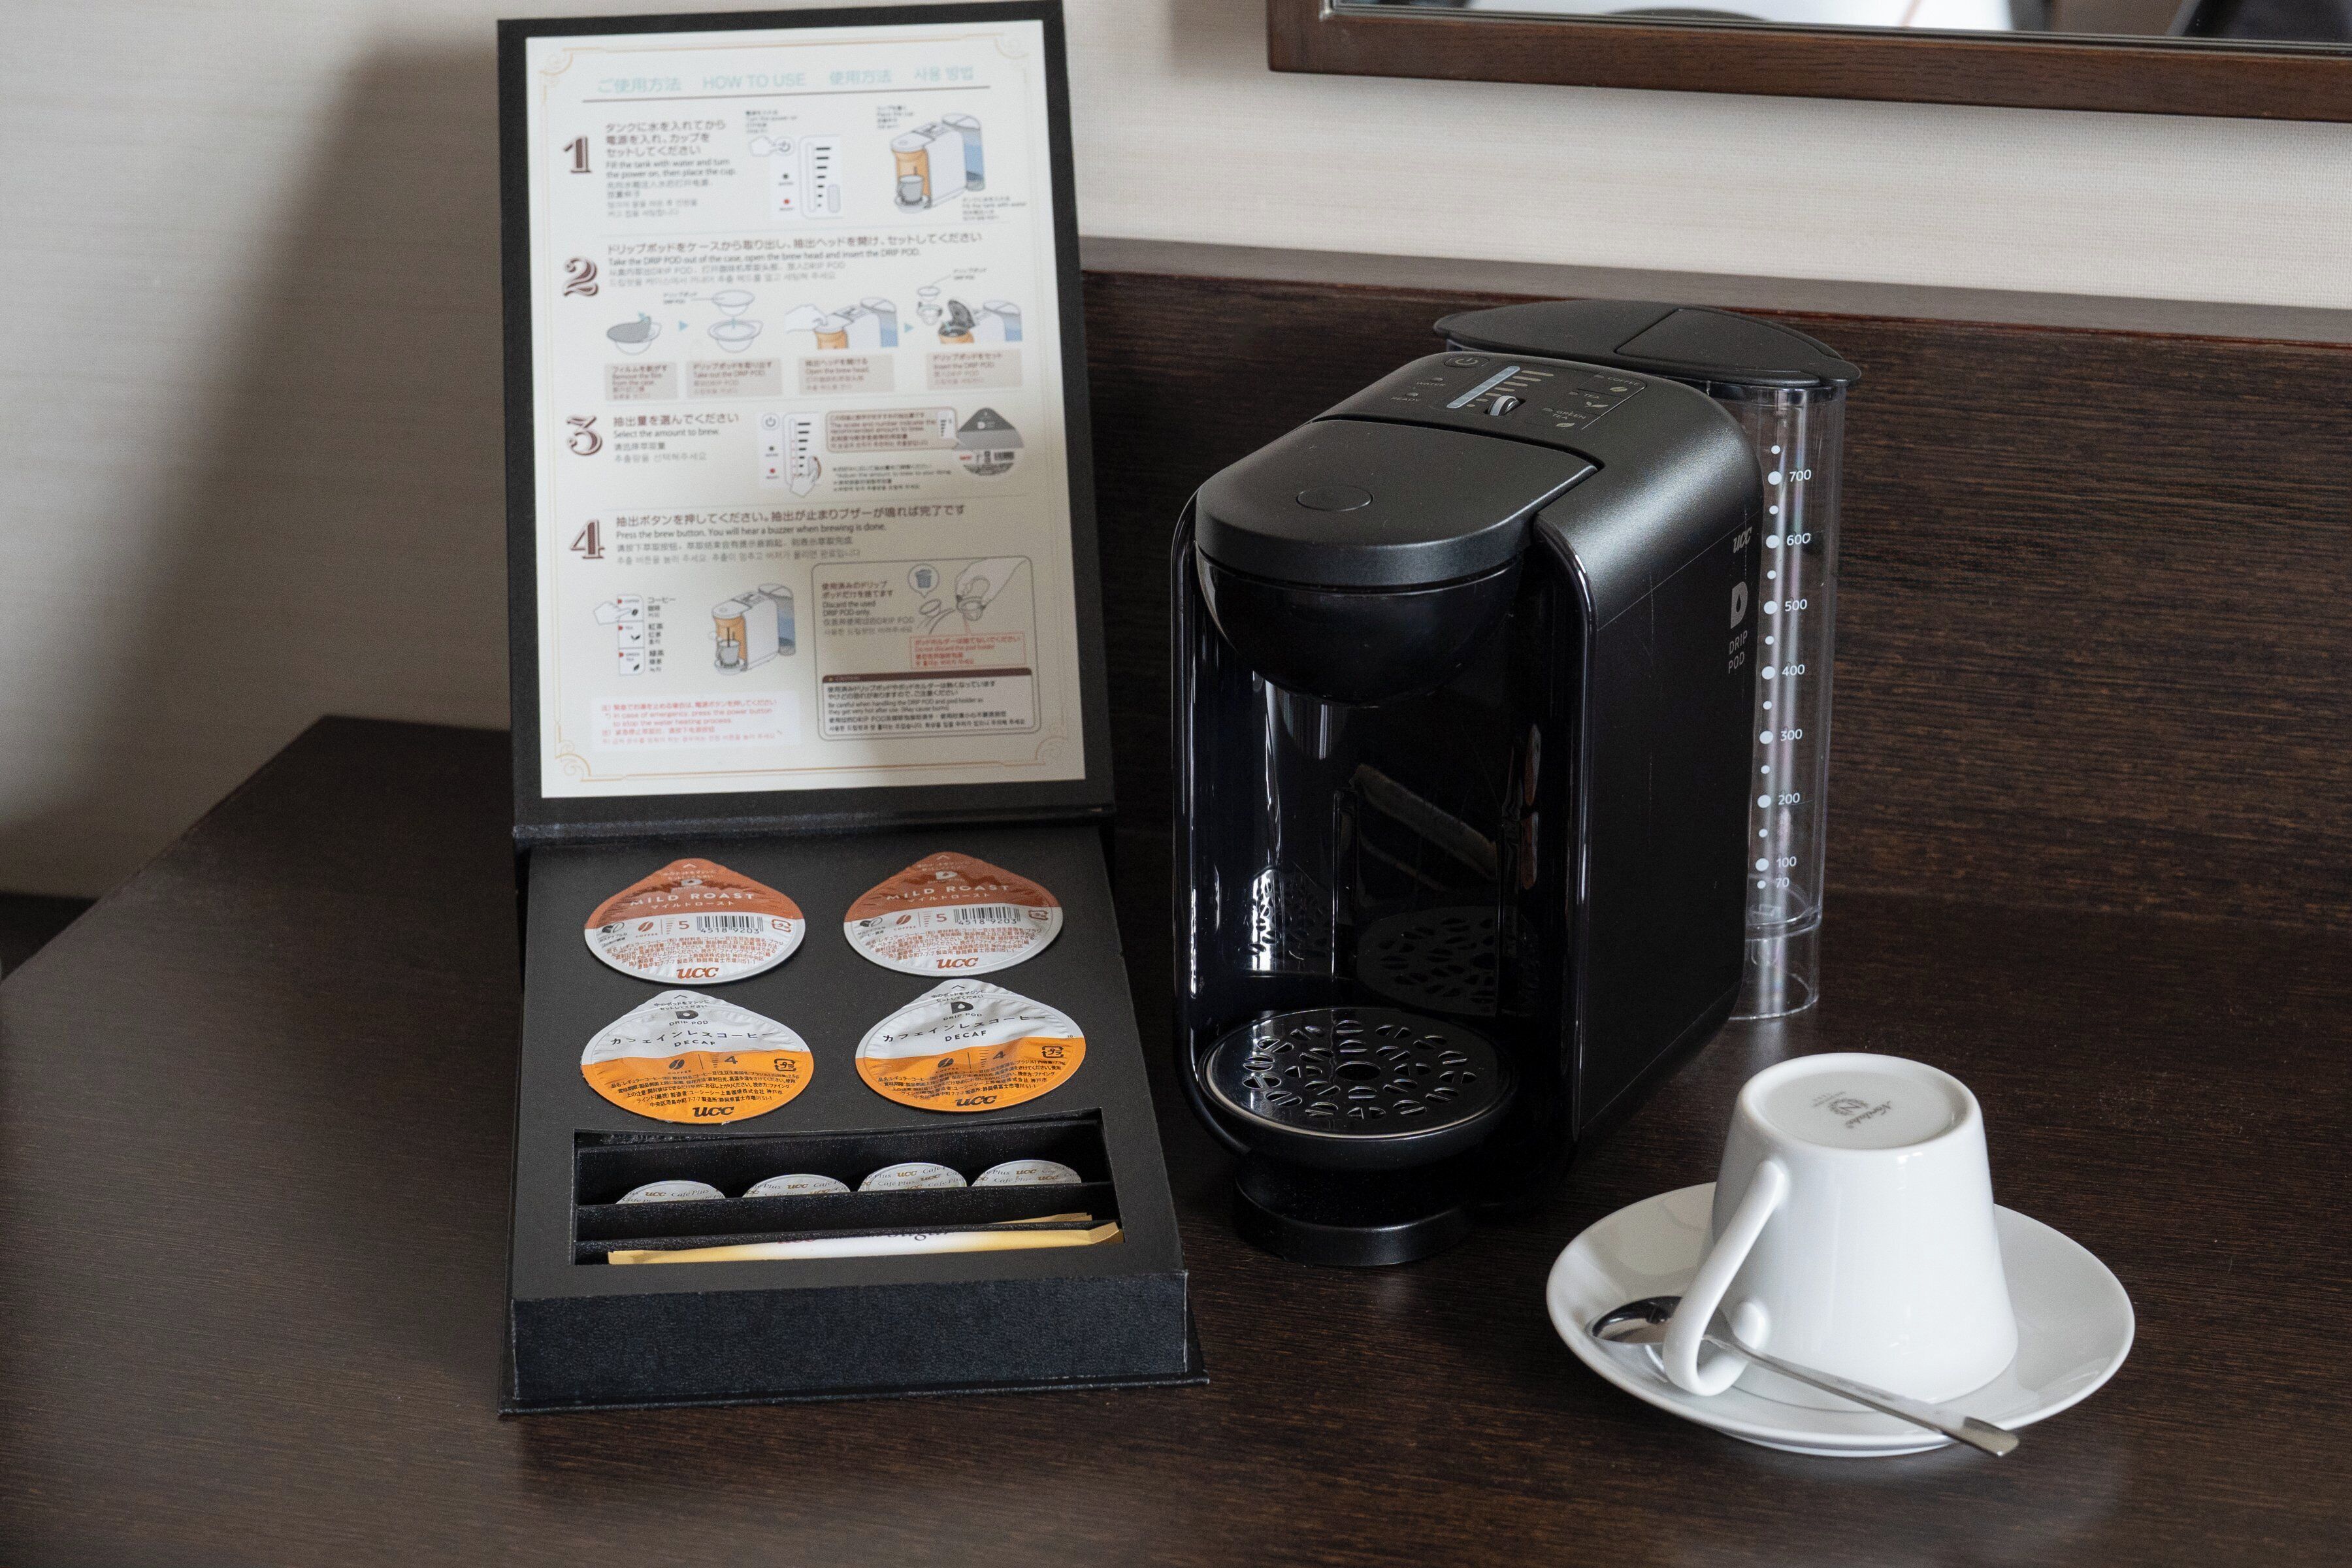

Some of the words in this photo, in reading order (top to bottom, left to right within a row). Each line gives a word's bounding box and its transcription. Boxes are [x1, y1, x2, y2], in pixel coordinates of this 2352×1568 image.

[702, 74, 743, 90] HOW
[747, 73, 769, 88] TO
[773, 72, 806, 88] USE
[829, 69, 892, 85] 使用方法
[597, 76, 681, 93] ご使用方法
[563, 135, 593, 174] 1
[606, 146, 702, 158] セットしてください
[654, 159, 670, 168] with
[696, 158, 711, 167] and
[621, 171, 645, 180] power
[683, 169, 703, 178] place
[608, 257, 626, 266] Take
[629, 257, 641, 265] the
[684, 255, 696, 264] out
[699, 254, 707, 263] of
[709, 254, 721, 263] the
[745, 253, 764, 264] open
[766, 253, 779, 261] the
[781, 252, 802, 261] brew
[804, 251, 823, 259] head
[825, 250, 840, 259] and
[843, 249, 864, 258] insert
[866, 249, 879, 257] the
[881, 248, 899, 257] DRIP
[563, 257, 599, 297] 2
[1607, 376, 1641, 386] COFFEE
[1556, 410, 1586, 419] GREEN
[566, 414, 603, 456] 3
[613, 429, 638, 438] Select
[640, 429, 652, 438] the
[655, 429, 685, 437] amount
[1789, 468, 1812, 483] 700
[616, 531, 637, 539] Press
[638, 530, 652, 538] the
[654, 529, 674, 538] brew
[708, 527, 724, 536] You
[726, 527, 740, 535] will
[742, 526, 760, 534] hear
[768, 525, 795, 534] buzzer
[796, 525, 819, 533] when
[821, 523, 854, 534] brewing
[856, 523, 862, 531] is
[569, 518, 606, 560] 4
[1786, 532, 1810, 547] 600
[1784, 599, 1808, 612] 500
[1729, 630, 1748, 655] DRIP
[1728, 651, 1745, 674] POD
[1782, 664, 1805, 677] 400
[1780, 728, 1803, 742] 300
[1778, 792, 1801, 805] 200
[1775, 856, 1797, 868] 100
[1775, 877, 1789, 889] 70
[887, 888, 935, 900] MILD
[946, 884, 1010, 892] ROAST
[630, 894, 679, 906] MILD
[936, 913, 947, 922] 5
[678, 921, 690, 930] 5
[883, 1015, 1045, 1042] カフェインレスコーヒー
[610, 1030, 774, 1045] カフェインレスコーヒー
[945, 1030, 987, 1042] DECAF
[674, 1039, 715, 1047] DECAF
[724, 1055, 739, 1064] 4
[992, 1051, 1007, 1060] 4
